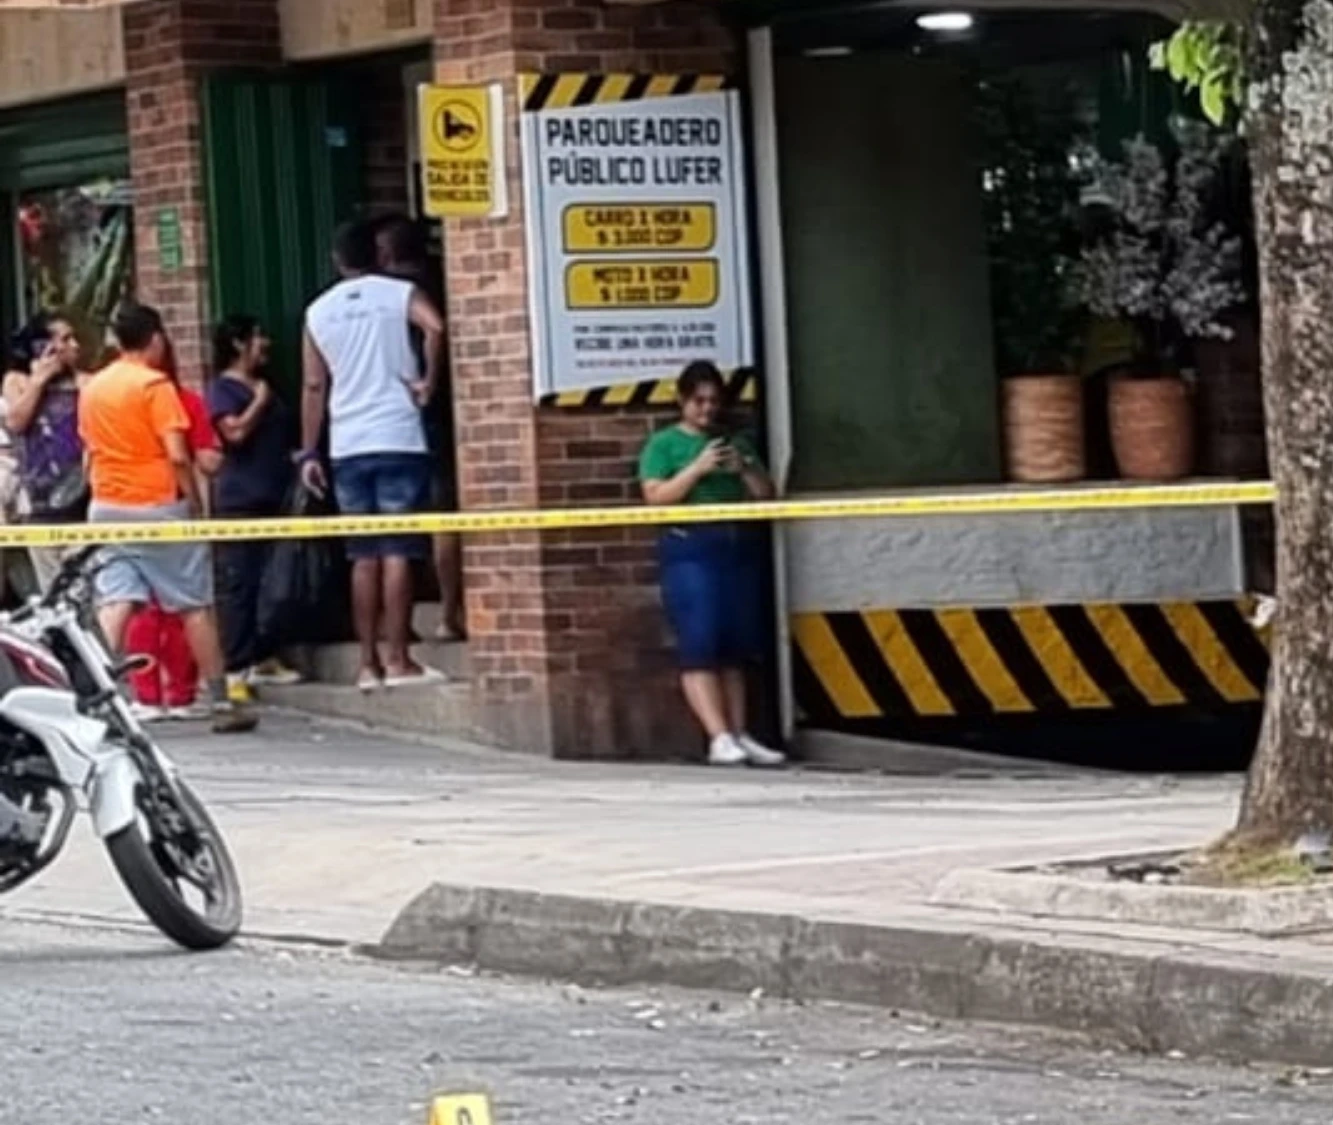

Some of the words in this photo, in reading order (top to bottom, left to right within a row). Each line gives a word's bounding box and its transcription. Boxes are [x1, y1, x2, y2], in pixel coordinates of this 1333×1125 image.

[546, 118, 721, 147] PARQUEADERO
[547, 150, 645, 185] PÚBLICO
[653, 157, 722, 184] LUFER
